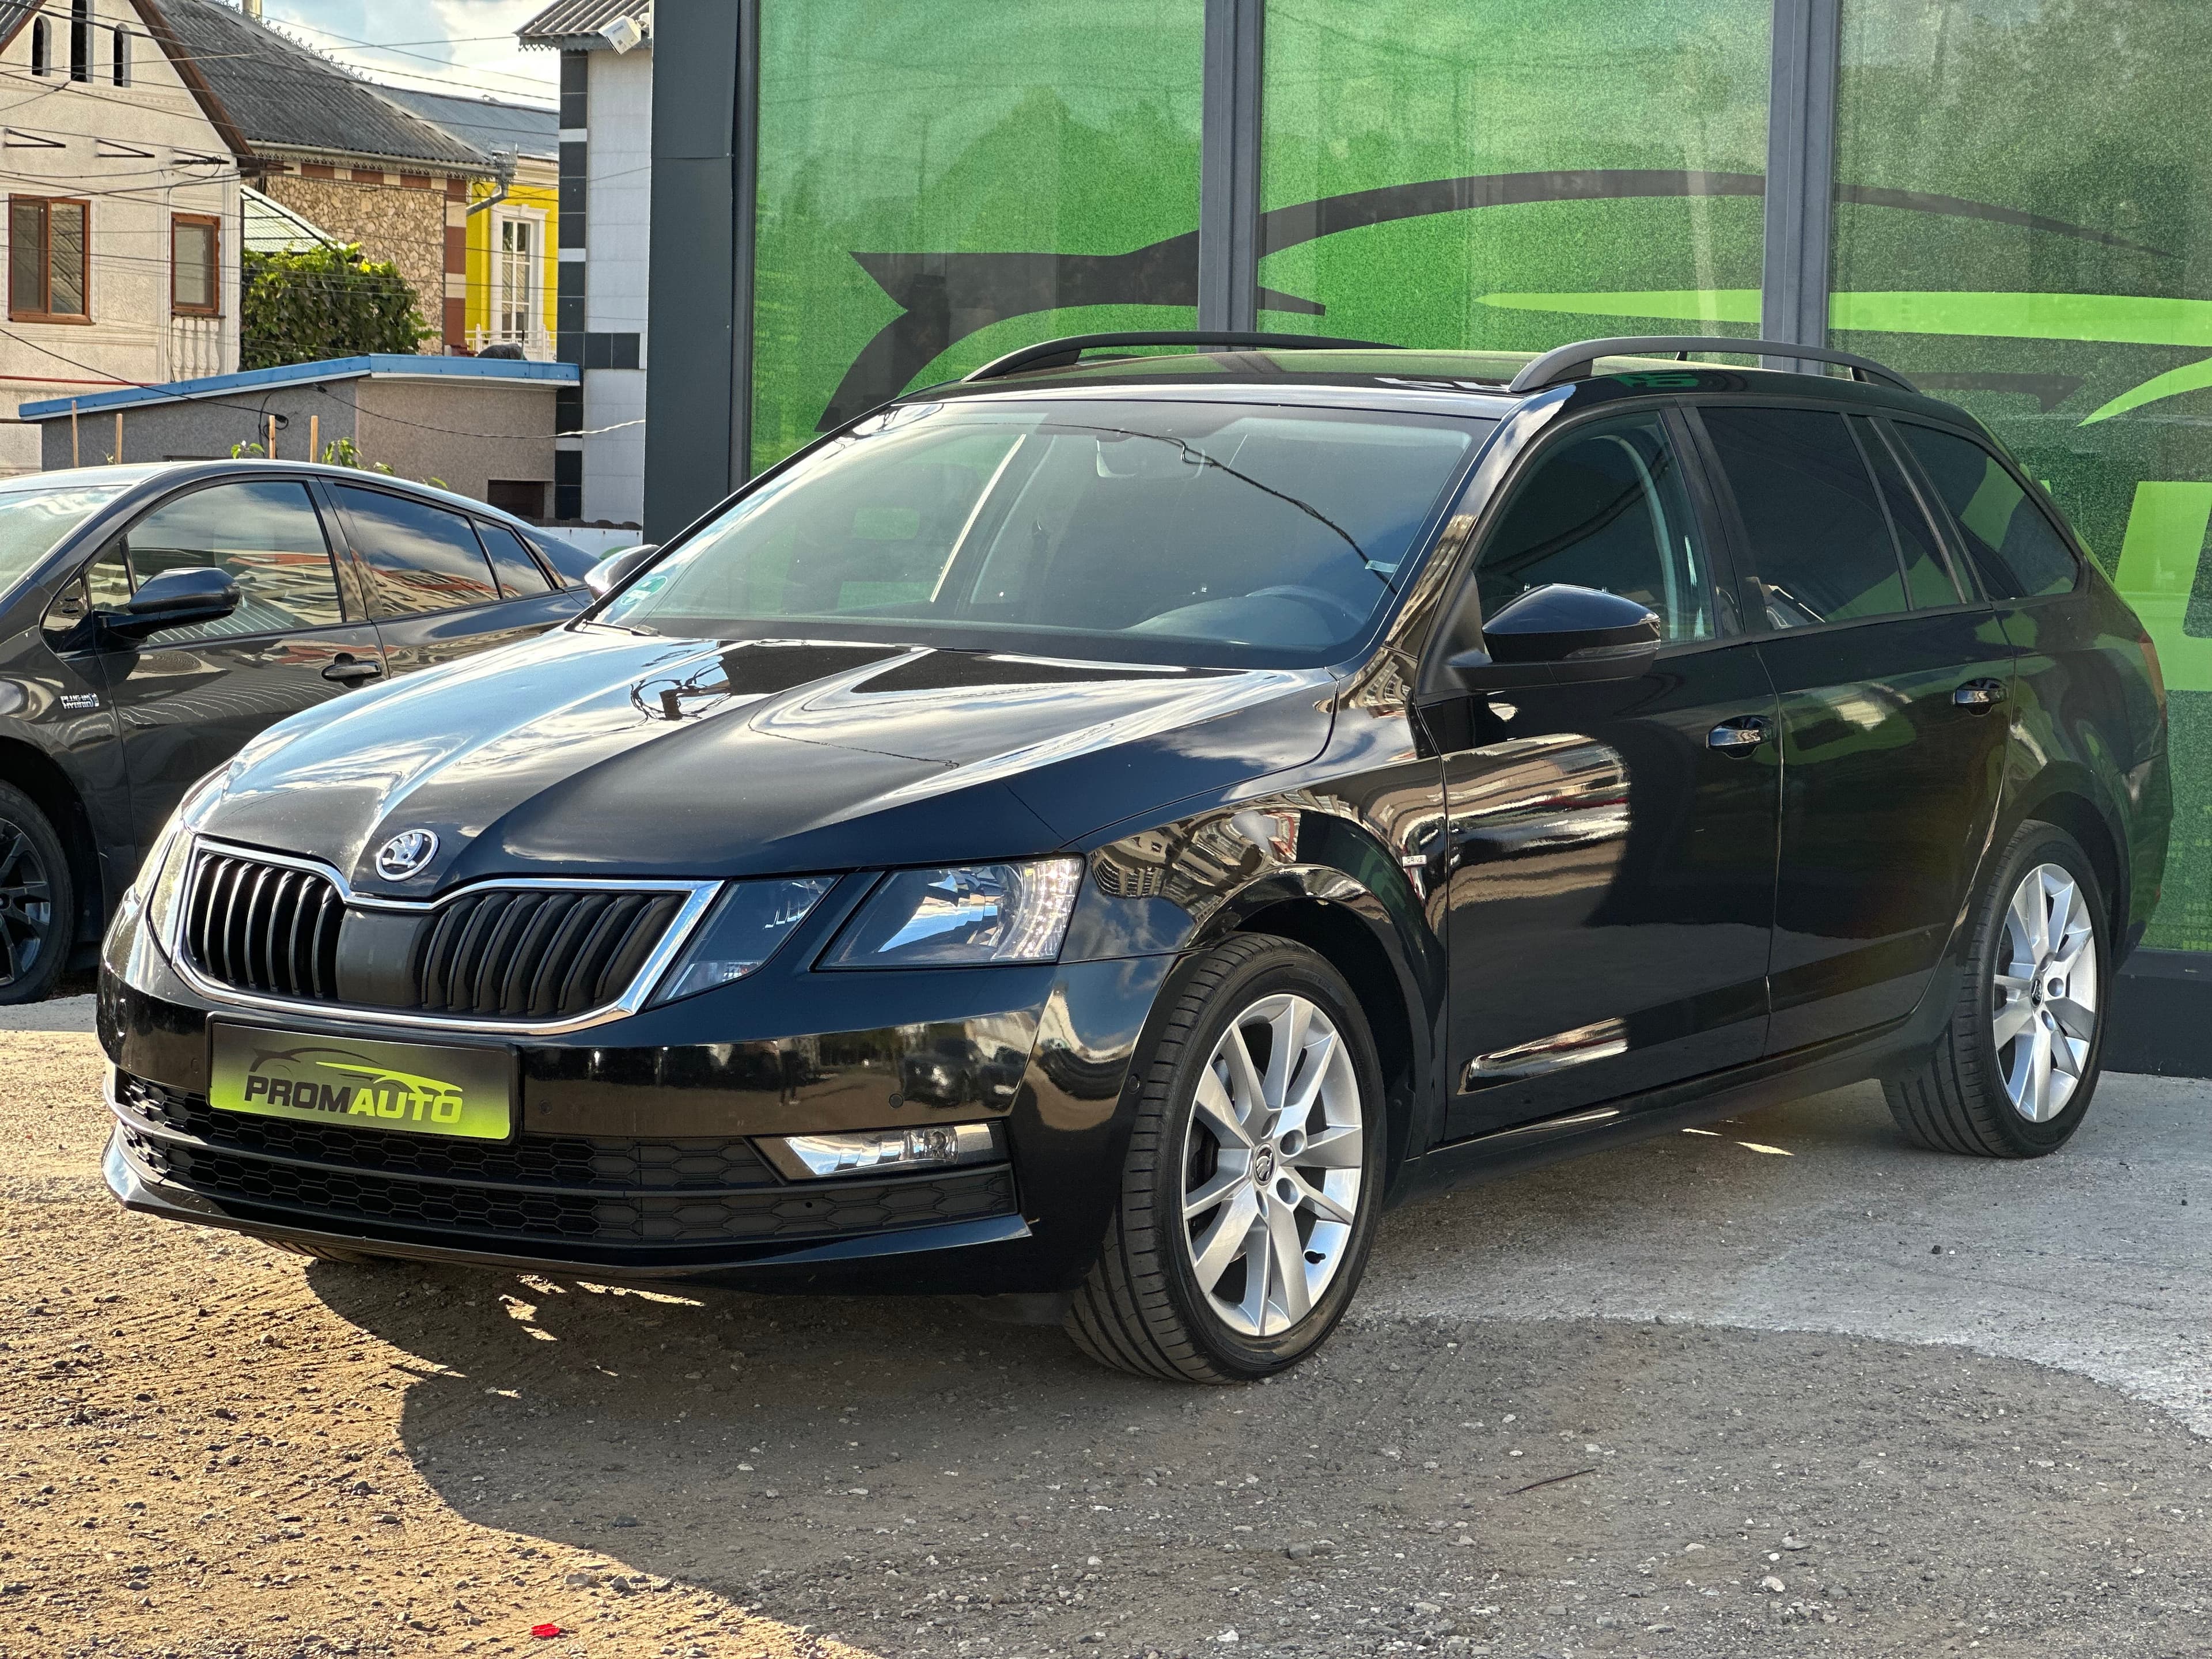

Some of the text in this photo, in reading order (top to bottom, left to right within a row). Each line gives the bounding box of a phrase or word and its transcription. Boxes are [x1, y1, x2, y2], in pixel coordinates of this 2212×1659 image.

[60, 694, 89, 702] PLUG-IN
[62, 700, 92, 709] HYBRID
[244, 1075, 463, 1124] PROMAUTO
